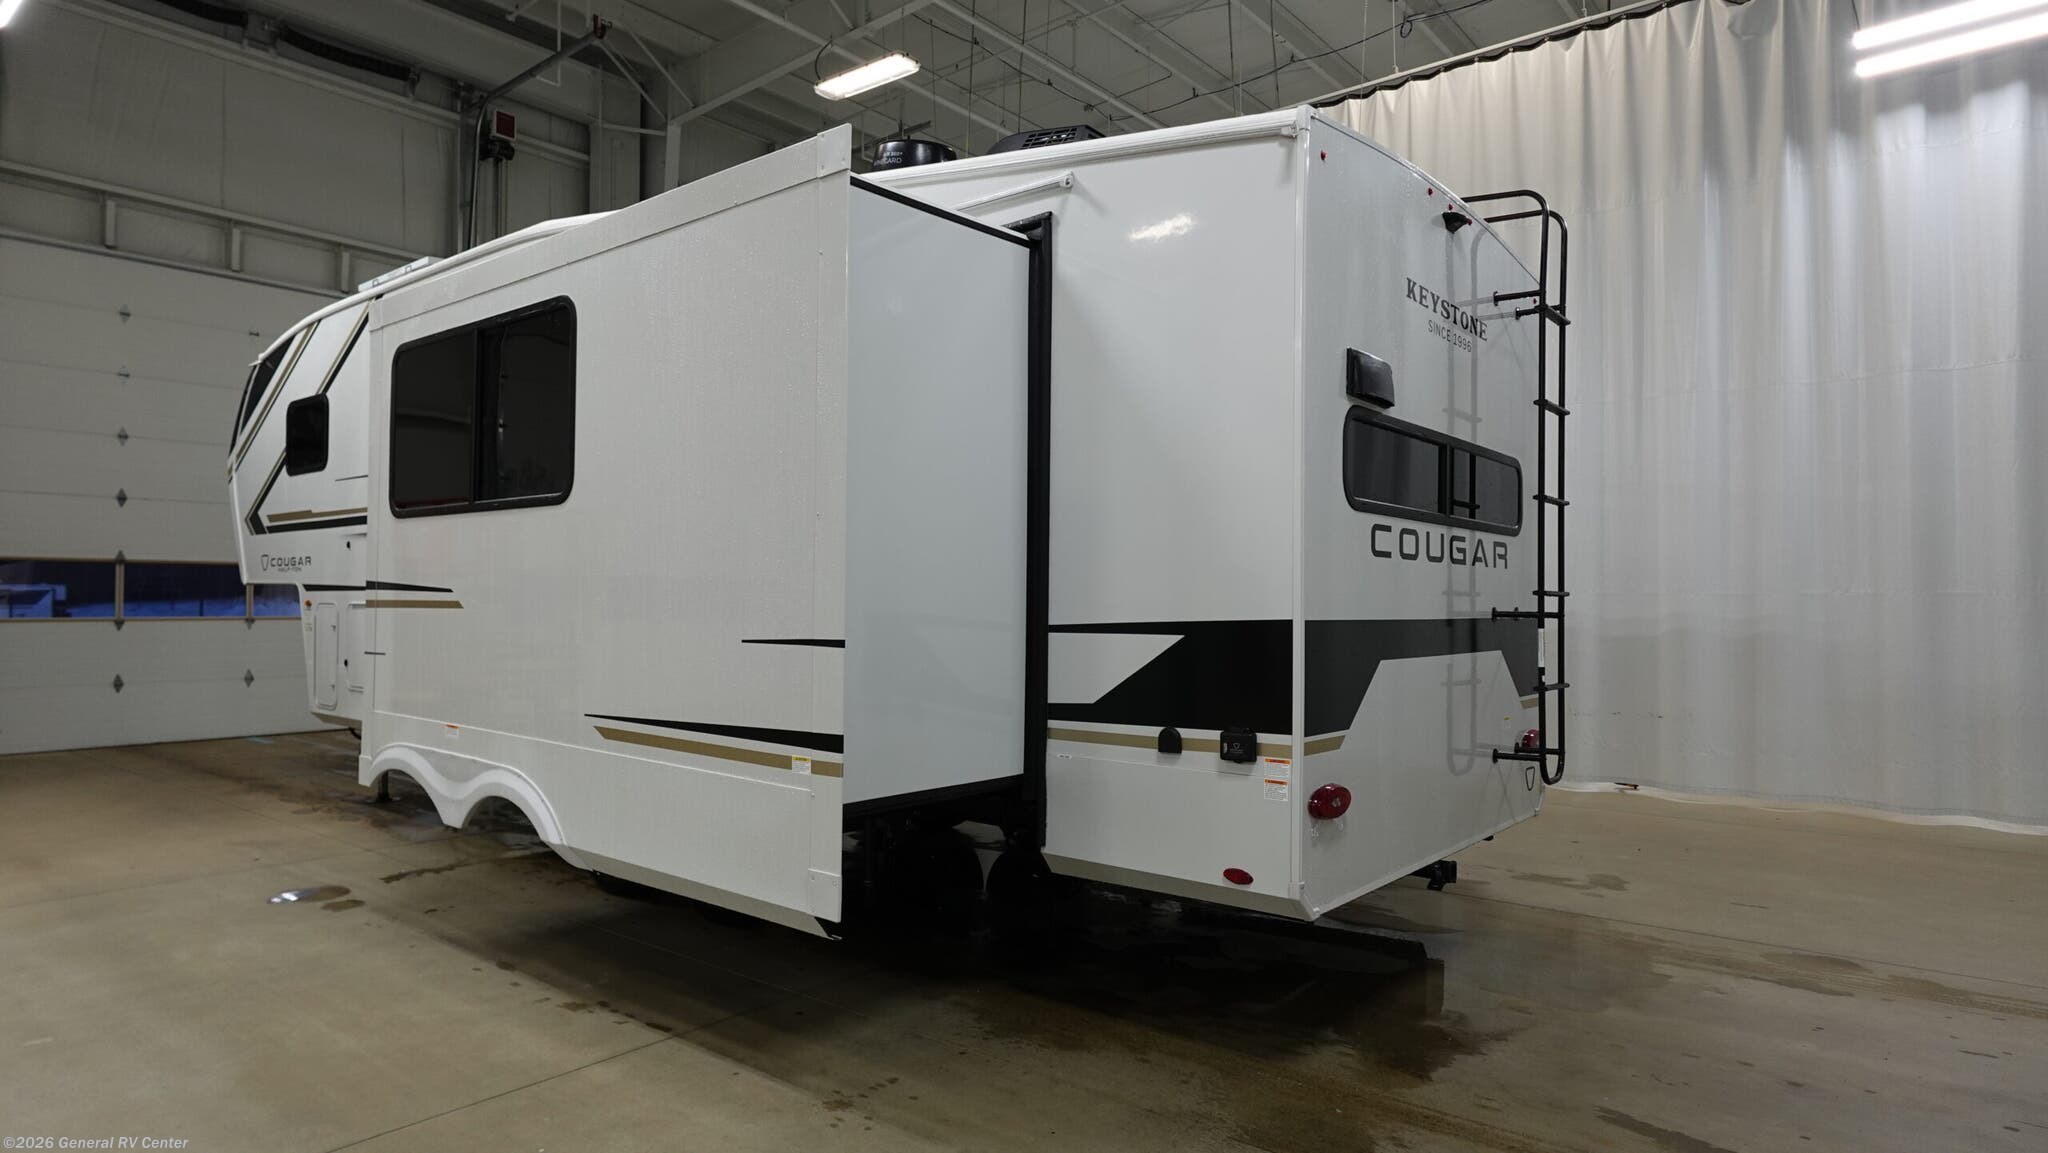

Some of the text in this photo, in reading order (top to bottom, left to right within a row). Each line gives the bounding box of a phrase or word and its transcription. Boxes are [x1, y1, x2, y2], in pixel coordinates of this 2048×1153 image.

[1406, 277, 1488, 341] KEYSTONE
[1428, 319, 1472, 353] SINCE 1996
[270, 556, 312, 567] COUGAR
[1371, 523, 1508, 569] COUGAR
